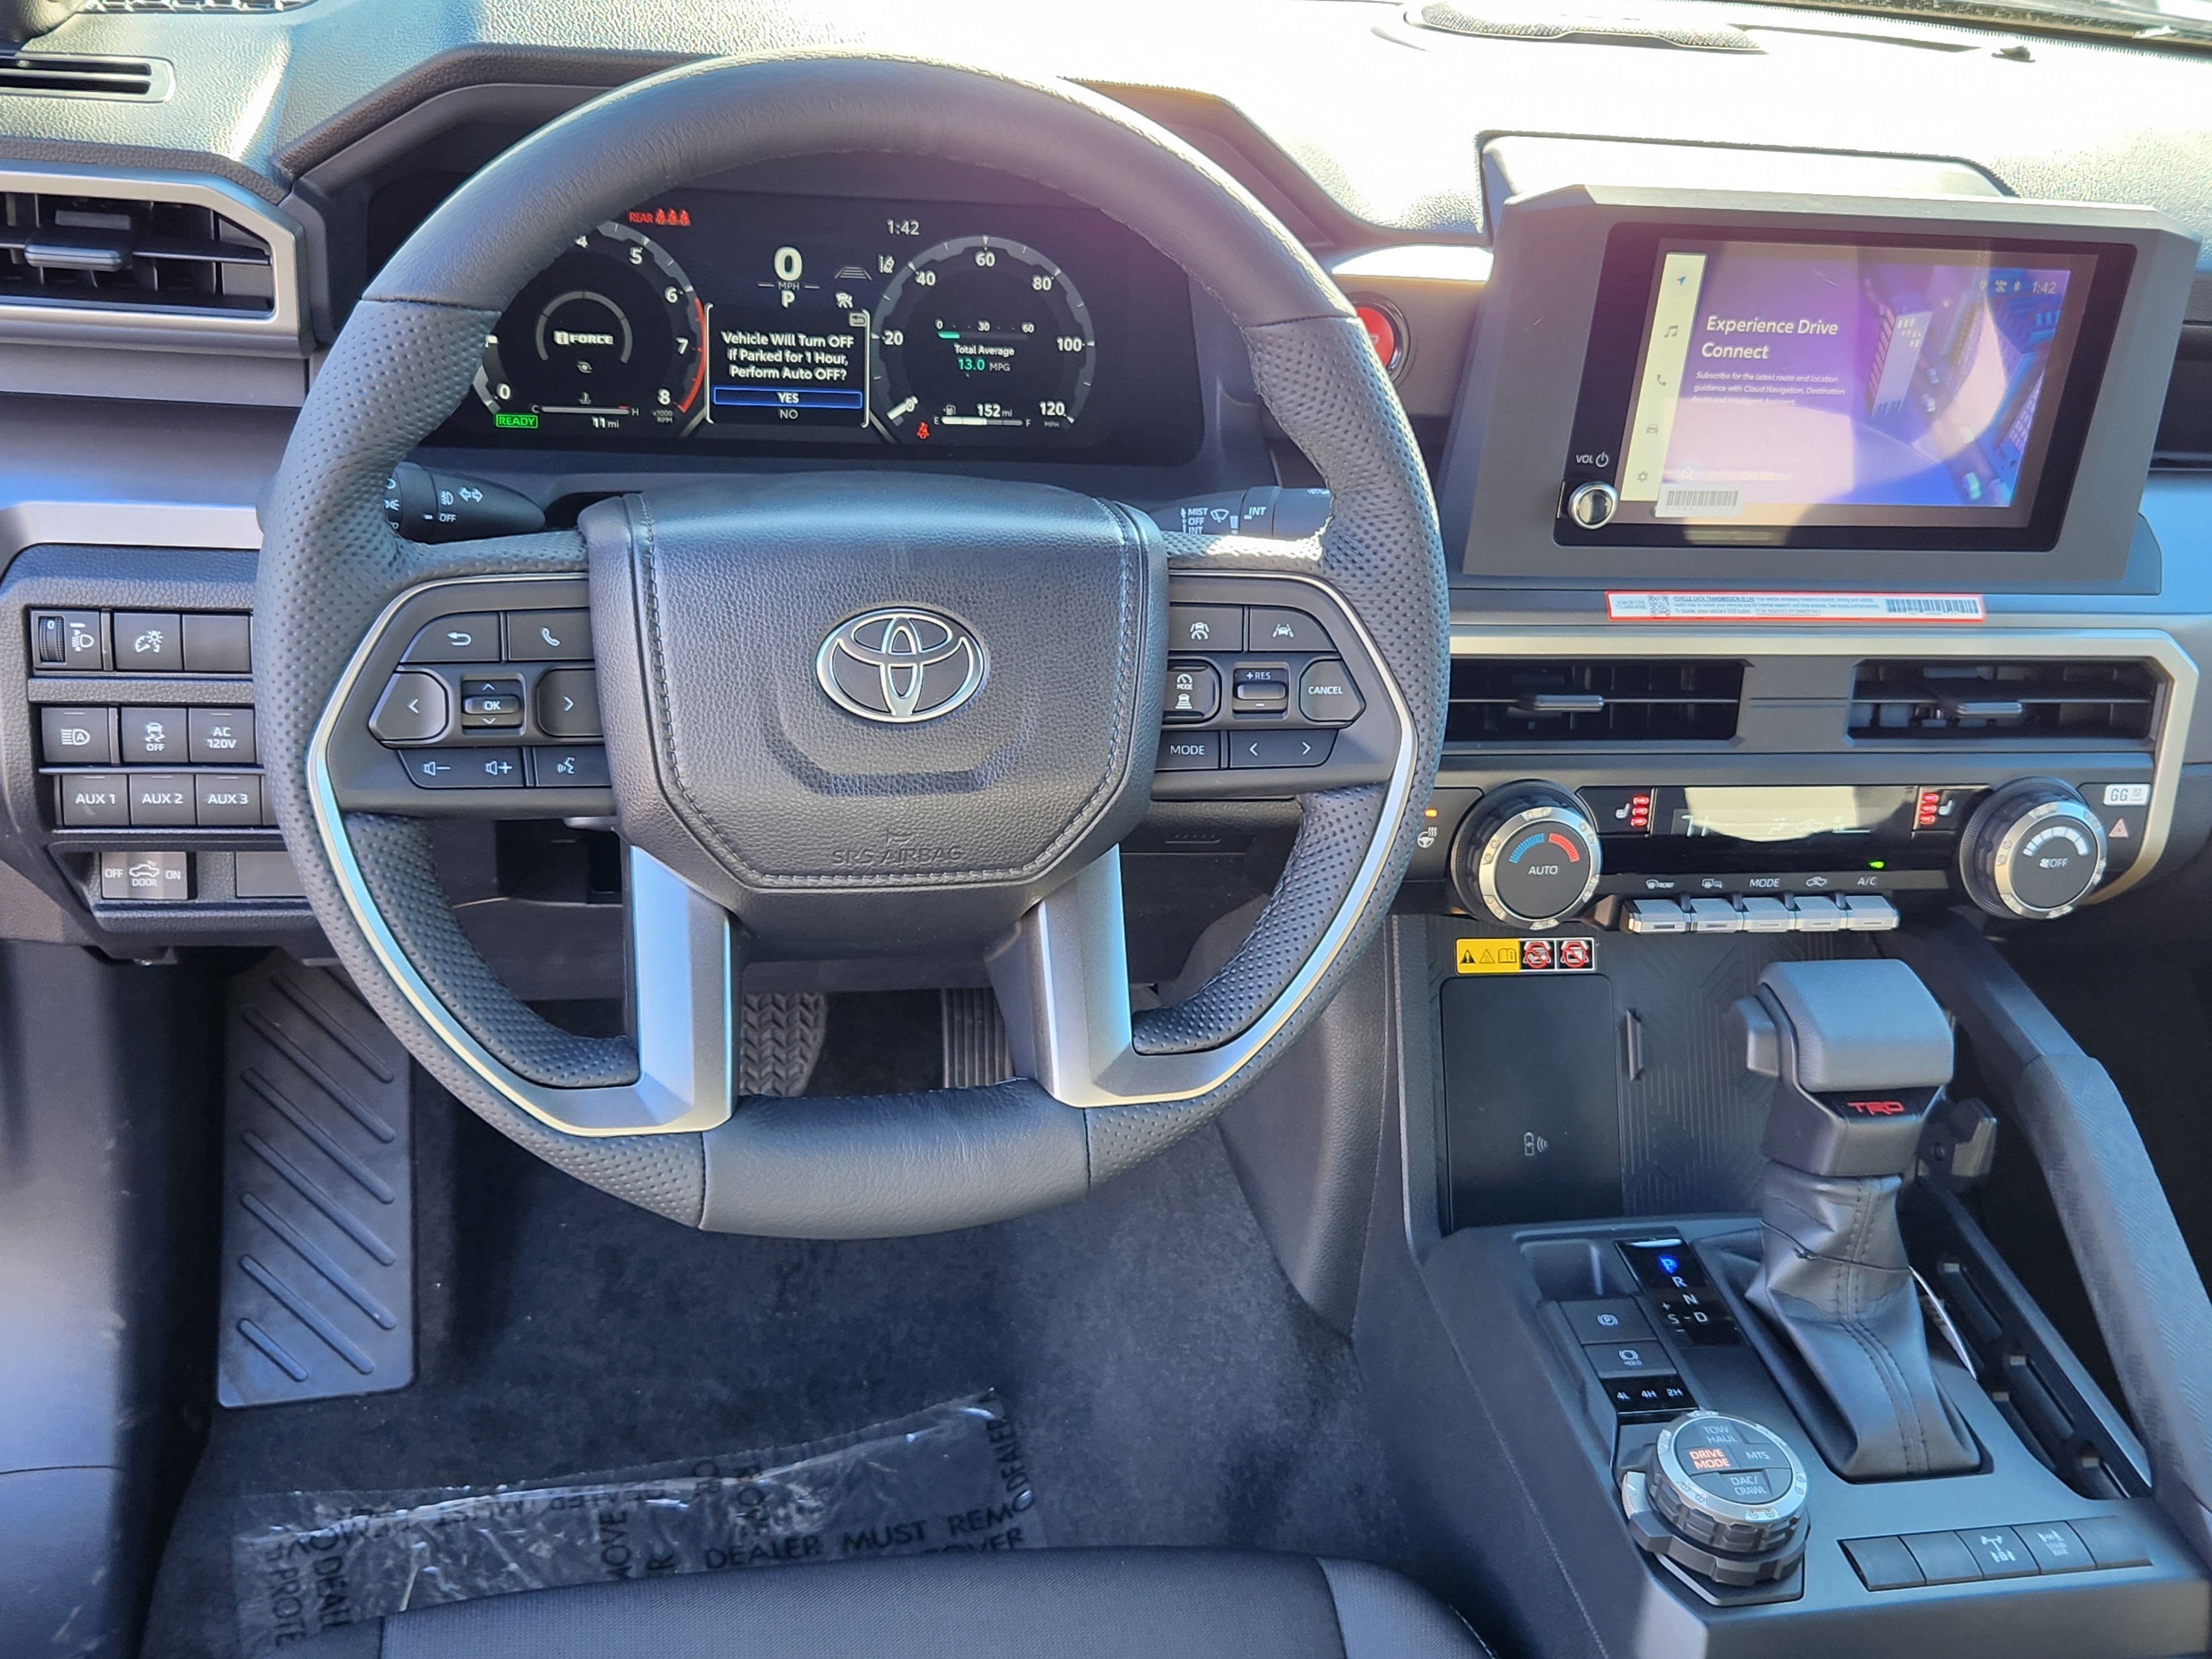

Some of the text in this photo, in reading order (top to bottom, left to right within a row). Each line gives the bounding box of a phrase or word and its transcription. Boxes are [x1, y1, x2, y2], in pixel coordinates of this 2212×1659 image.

[628, 212, 653, 223] REAR
[886, 220, 920, 236] 1:42
[629, 247, 643, 264] 5
[975, 252, 995, 267] 60
[774, 246, 803, 281] 0
[915, 271, 936, 286] 40
[1031, 276, 1052, 291] 80
[778, 281, 800, 291] MPH
[2032, 281, 2057, 295] 1:42
[664, 286, 678, 303] 6
[780, 291, 795, 307] P
[936, 320, 943, 330] 0
[977, 321, 990, 332] 30
[1021, 323, 1035, 333] 60
[1706, 315, 1839, 336] Experience Drive
[720, 331, 854, 348] Vehicle Will Turn OFF
[884, 331, 904, 346] 20
[676, 337, 688, 354] 7
[1056, 337, 1082, 352] 100
[953, 344, 1015, 358] Total Average
[1701, 342, 1769, 359] Connect
[739, 348, 781, 363] Parked
[784, 350, 802, 363] for
[804, 351, 811, 364] 1
[813, 351, 849, 366] Hour,
[957, 358, 1011, 372] 13.0 MPG
[729, 366, 847, 381] Perform Auto OFF?
[498, 384, 511, 400] 0
[658, 389, 671, 405] 8
[777, 392, 799, 404] YES
[531, 404, 540, 414] C
[631, 408, 639, 416] H
[977, 403, 1013, 418] 152 mi
[1039, 401, 1066, 416] 120
[779, 409, 798, 420] NO
[499, 416, 536, 427] READY
[591, 415, 620, 429] 11 mi
[933, 416, 940, 425] E
[1025, 418, 1031, 427] F
[1575, 455, 1593, 465] VOL
[1187, 508, 1208, 516] MIST
[1248, 507, 1266, 516] INT
[439, 513, 457, 523] OFF
[1187, 517, 1205, 525] OFF
[48, 620, 55, 629] 0
[1308, 686, 1343, 695] CANCEL
[484, 700, 501, 711] OK
[213, 727, 231, 737] AC
[207, 739, 237, 749] 120V
[1170, 745, 1206, 755] MODE
[75, 794, 116, 804] AUX 1
[142, 794, 184, 804] AUX 2
[208, 794, 249, 804] AUX 3
[877, 847, 964, 866] AIRBAG
[2049, 857, 2068, 868] OFF
[105, 869, 123, 878] OFF
[166, 870, 181, 880] ON
[1528, 865, 1558, 877] AUTO
[132, 878, 157, 887] DOOR
[1749, 877, 1780, 888] MODE
[1857, 876, 1877, 887] A/C
[1847, 1101, 1904, 1115] TRD
[1660, 1256, 1677, 1273] P
[1672, 1276, 1688, 1288] R
[1682, 1293, 1699, 1305] N
[1667, 1313, 1680, 1324] S
[1693, 1312, 1708, 1323] D
[1616, 1391, 1631, 1400] 4L
[1641, 1389, 1658, 1399] 4H
[1703, 1425, 1729, 1434] TOW
[1706, 1435, 1738, 1444] HAUL
[1688, 1448, 1726, 1460] DRIVE
[1745, 1451, 1770, 1460] MTS
[1693, 1458, 1731, 1470] MODE
[1734, 1485, 1767, 1495] CRAWL
[703, 1533, 821, 1569] DEALER
[842, 1518, 927, 1551] MUST
